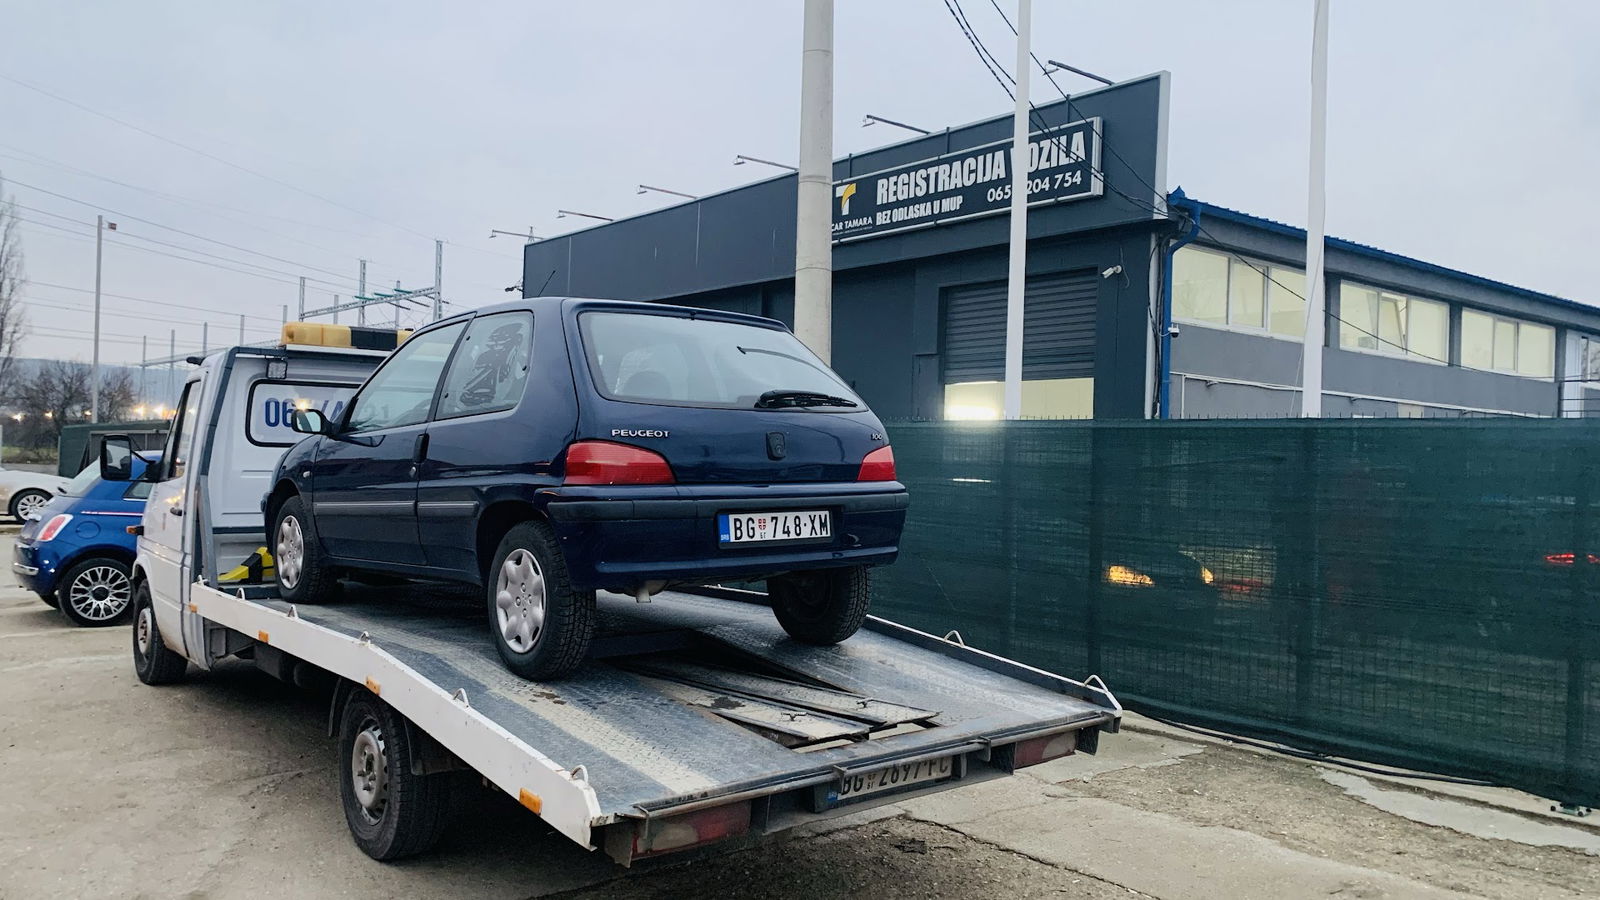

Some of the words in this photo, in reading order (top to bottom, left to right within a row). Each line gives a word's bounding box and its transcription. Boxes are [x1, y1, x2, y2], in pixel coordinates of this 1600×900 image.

[877, 150, 1006, 205] REGISTRACIJA
[1010, 131, 1086, 173] OZILA
[1054, 170, 1082, 189] 754
[876, 210, 892, 226] BEZ
[892, 202, 932, 222] ODLASKA
[933, 199, 941, 214] U
[941, 195, 963, 213] MUP
[844, 216, 873, 229] TAMARA
[611, 429, 670, 438] PEUGEOT
[733, 517, 756, 541] BG
